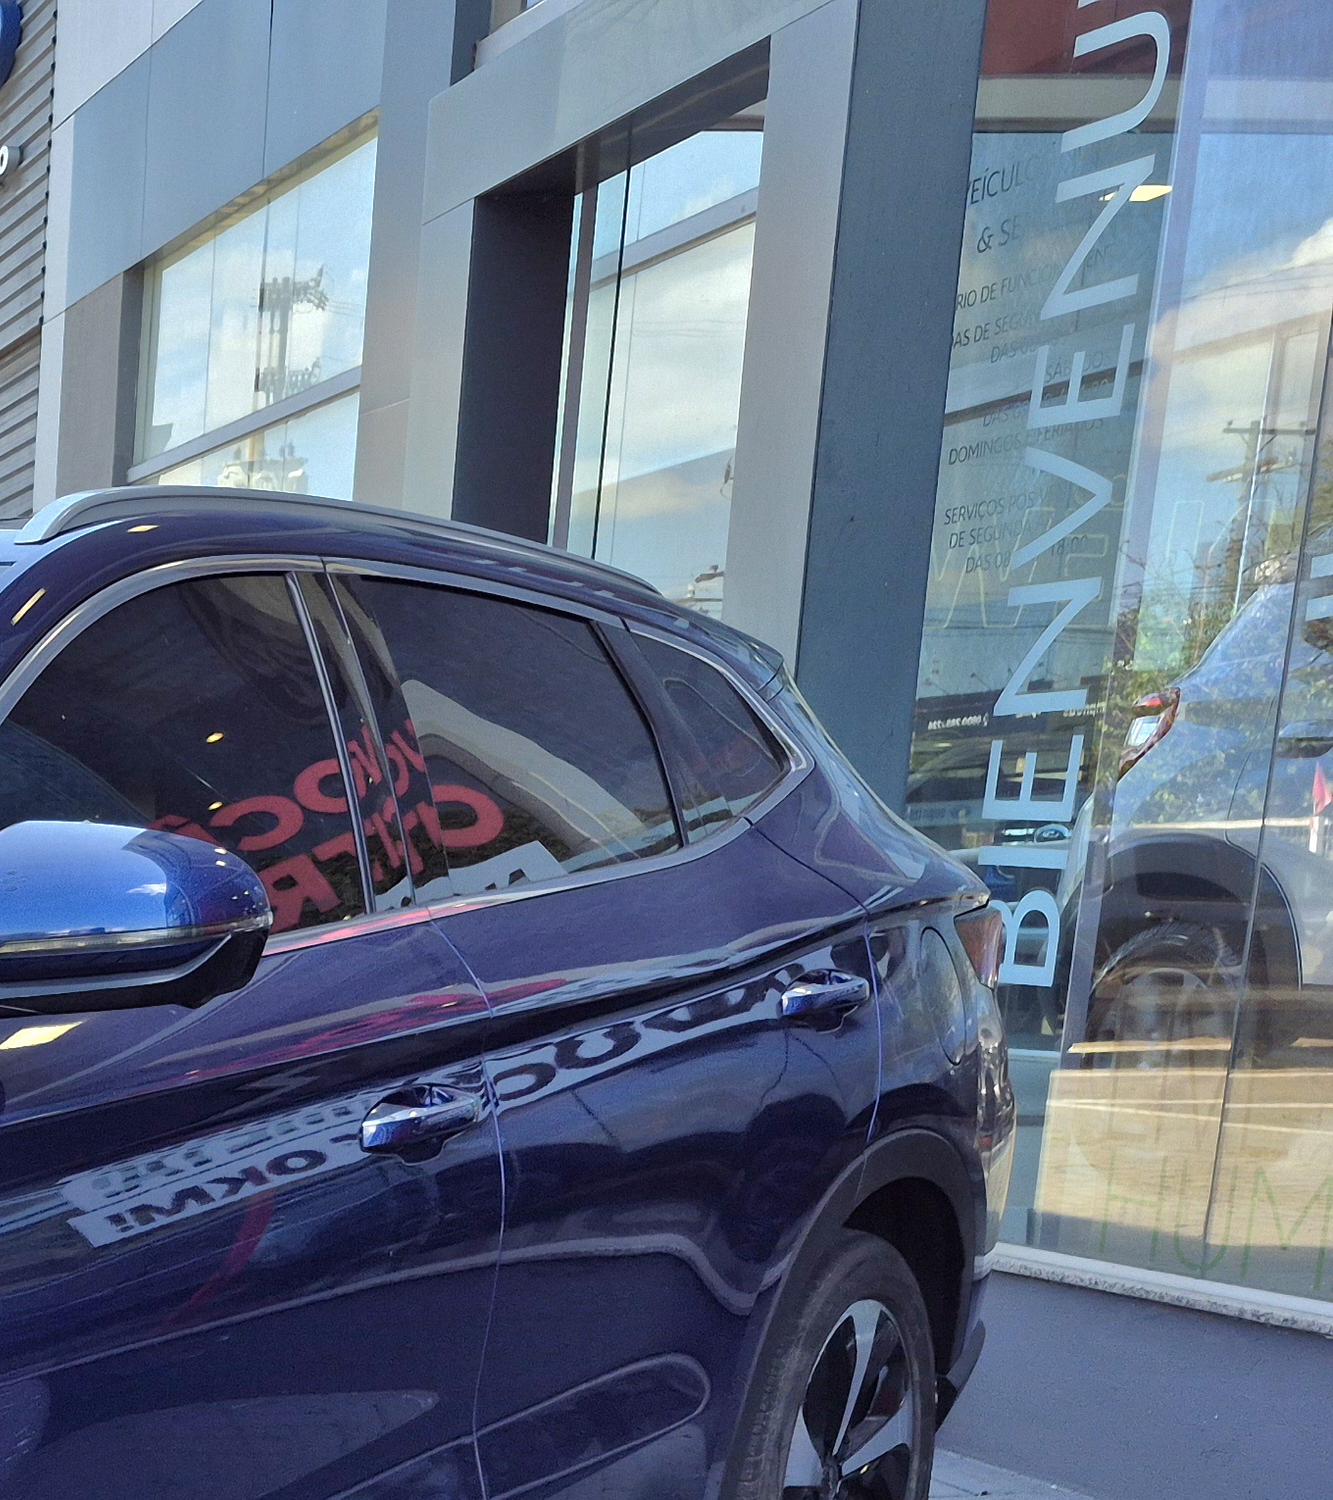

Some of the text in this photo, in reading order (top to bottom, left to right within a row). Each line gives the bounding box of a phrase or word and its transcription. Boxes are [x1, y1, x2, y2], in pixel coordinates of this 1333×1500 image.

[980, 284, 996, 304] DE
[973, 324, 990, 343] DE
[979, 0, 1171, 988] BIENVENU
[949, 532, 966, 549] DE
[965, 556, 992, 574] DAS
